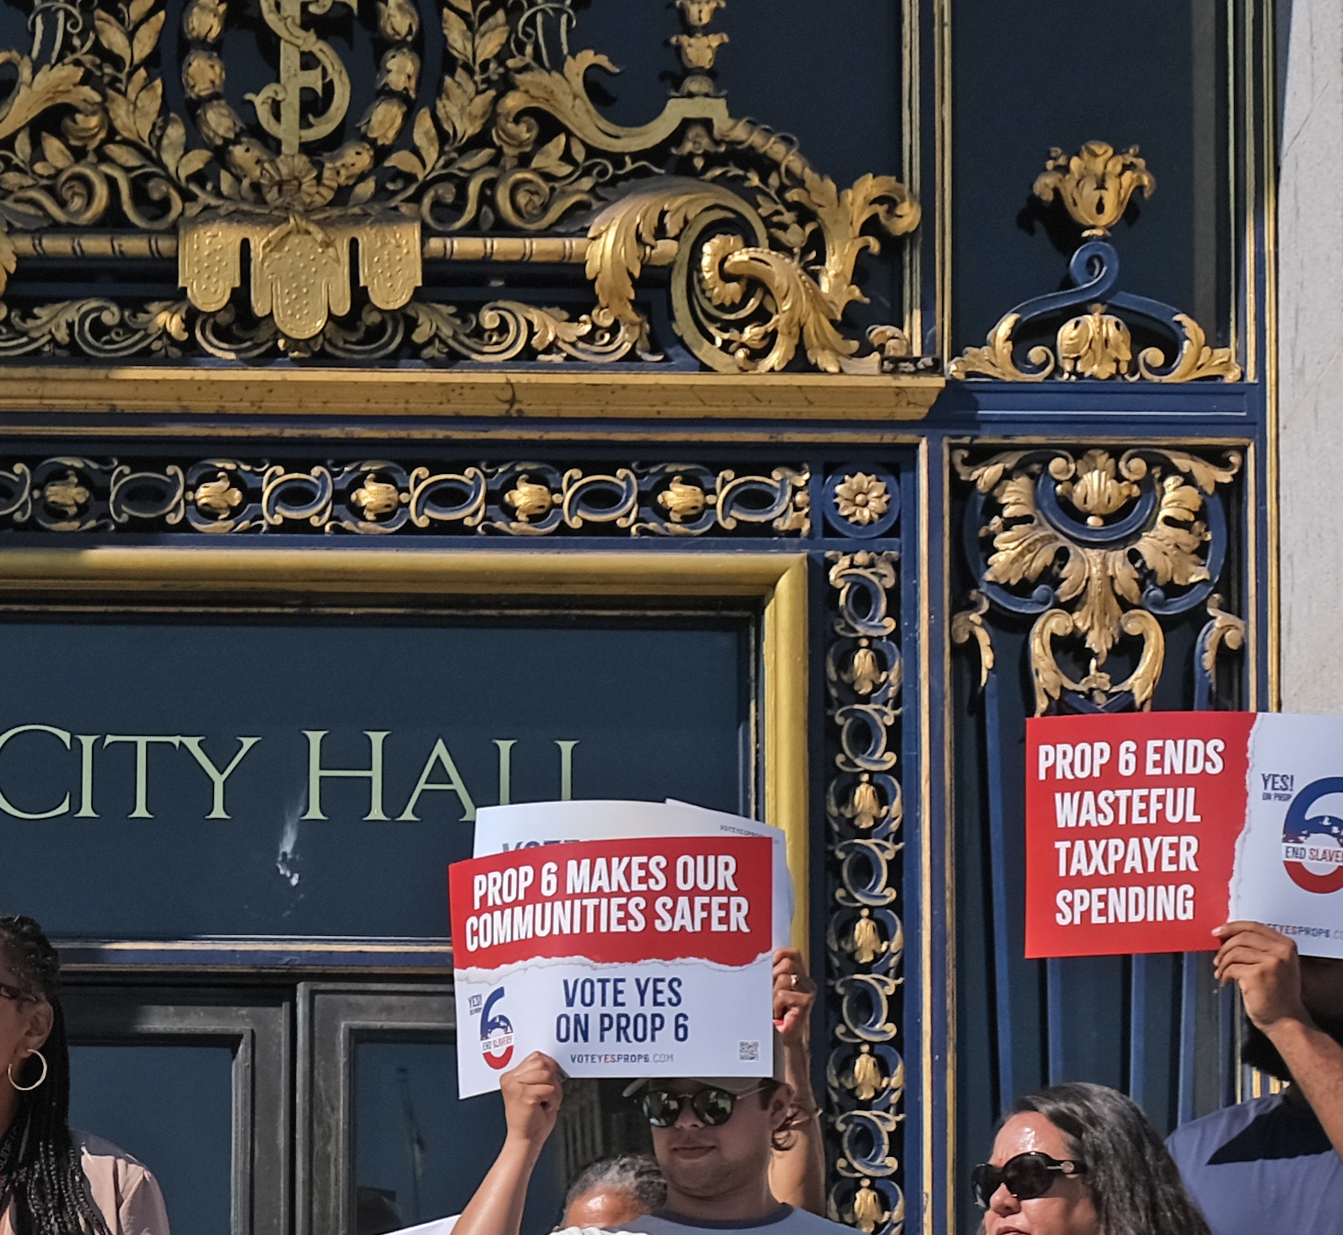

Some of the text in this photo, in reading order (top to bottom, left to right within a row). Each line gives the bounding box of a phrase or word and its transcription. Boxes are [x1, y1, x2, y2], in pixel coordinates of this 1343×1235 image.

[1038, 738, 1225, 780] PROP 6 ENDS
[1261, 773, 1294, 792] YES!
[1054, 787, 1202, 828] WASTEFUL
[1054, 835, 1199, 877] TAXPAYER
[1285, 846, 1306, 859] END
[473, 854, 738, 911] PROP 6 MAKES OUR
[466, 896, 751, 953] COMMUNITIES SAFER
[1056, 884, 1195, 926] SPENDING
[562, 977, 683, 1008] VOTE YES
[556, 1013, 689, 1044] ON PROP 6
